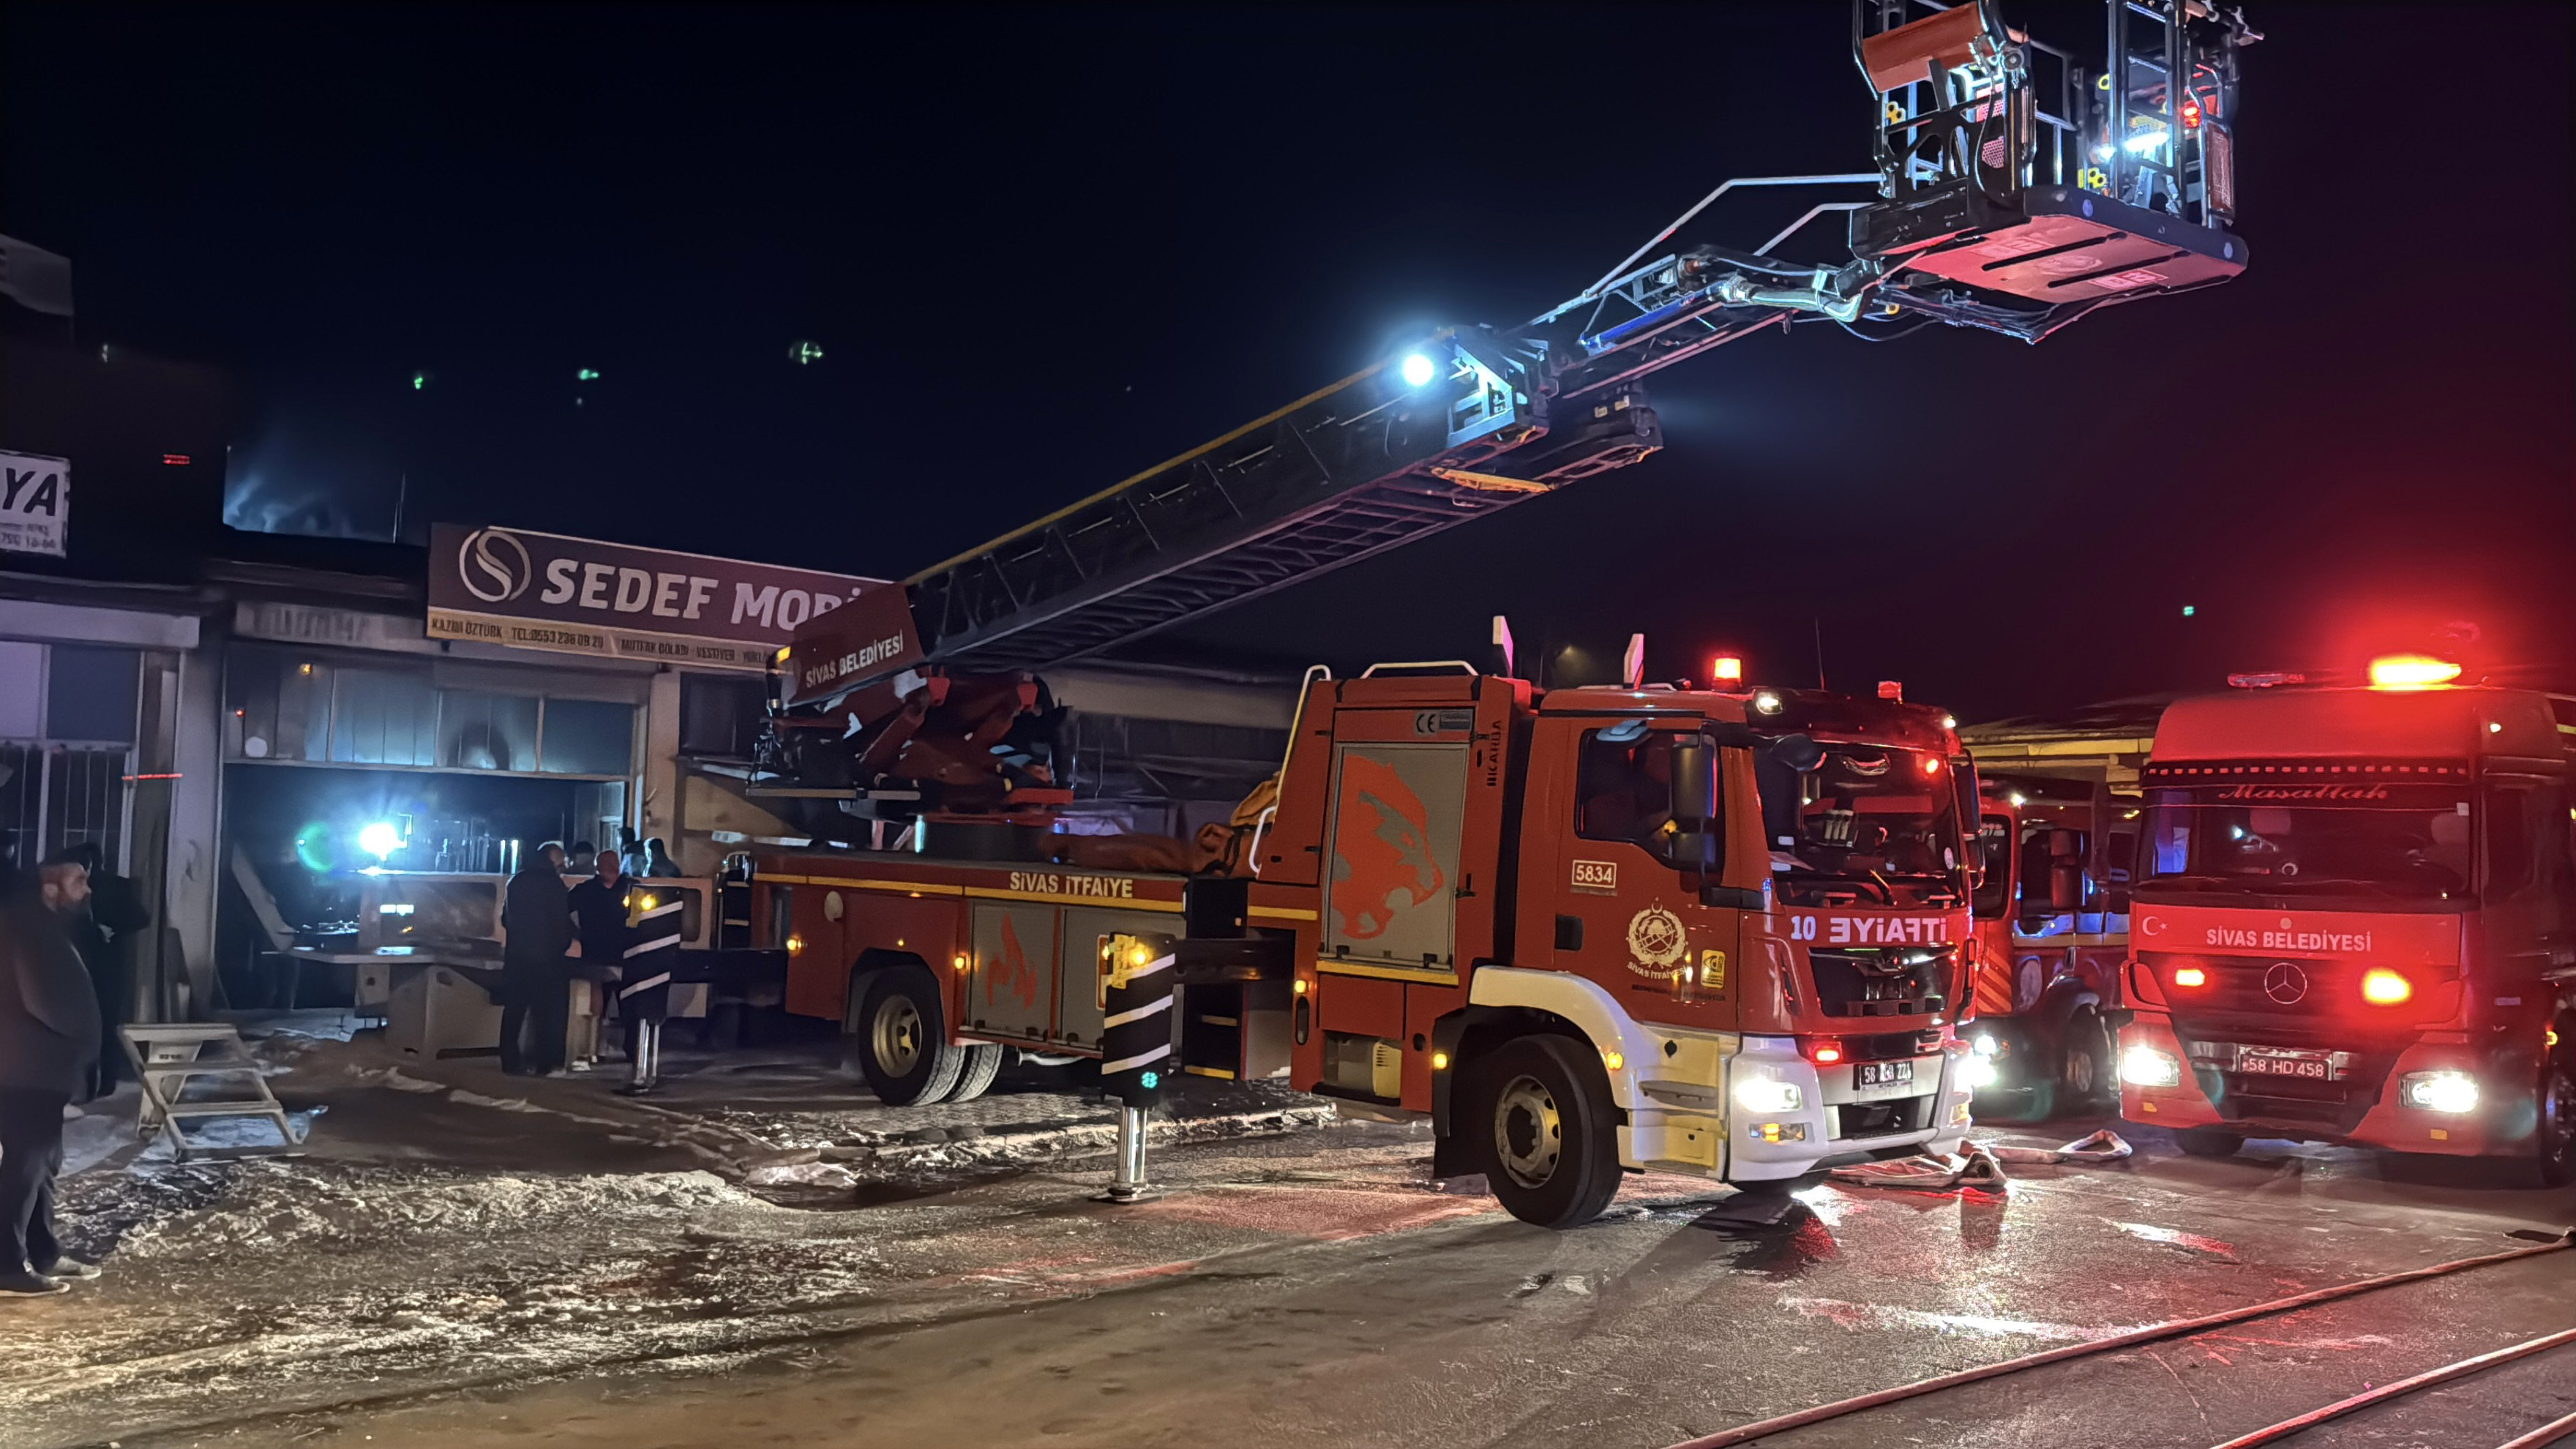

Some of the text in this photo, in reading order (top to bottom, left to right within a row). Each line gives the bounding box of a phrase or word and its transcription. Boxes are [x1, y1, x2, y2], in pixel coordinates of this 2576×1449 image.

[2, 467, 58, 517] YA
[540, 558, 861, 632] SEDEF MOB
[806, 629, 903, 688] SİVAS BELEDİYESİ
[1576, 864, 1612, 883] 5834
[1791, 916, 1816, 940] 10
[2206, 925, 2372, 951] SİVAS BELEDİYESİ
[1864, 1066, 1876, 1083] 58
[2249, 1058, 2324, 1077] 58 HD 458
